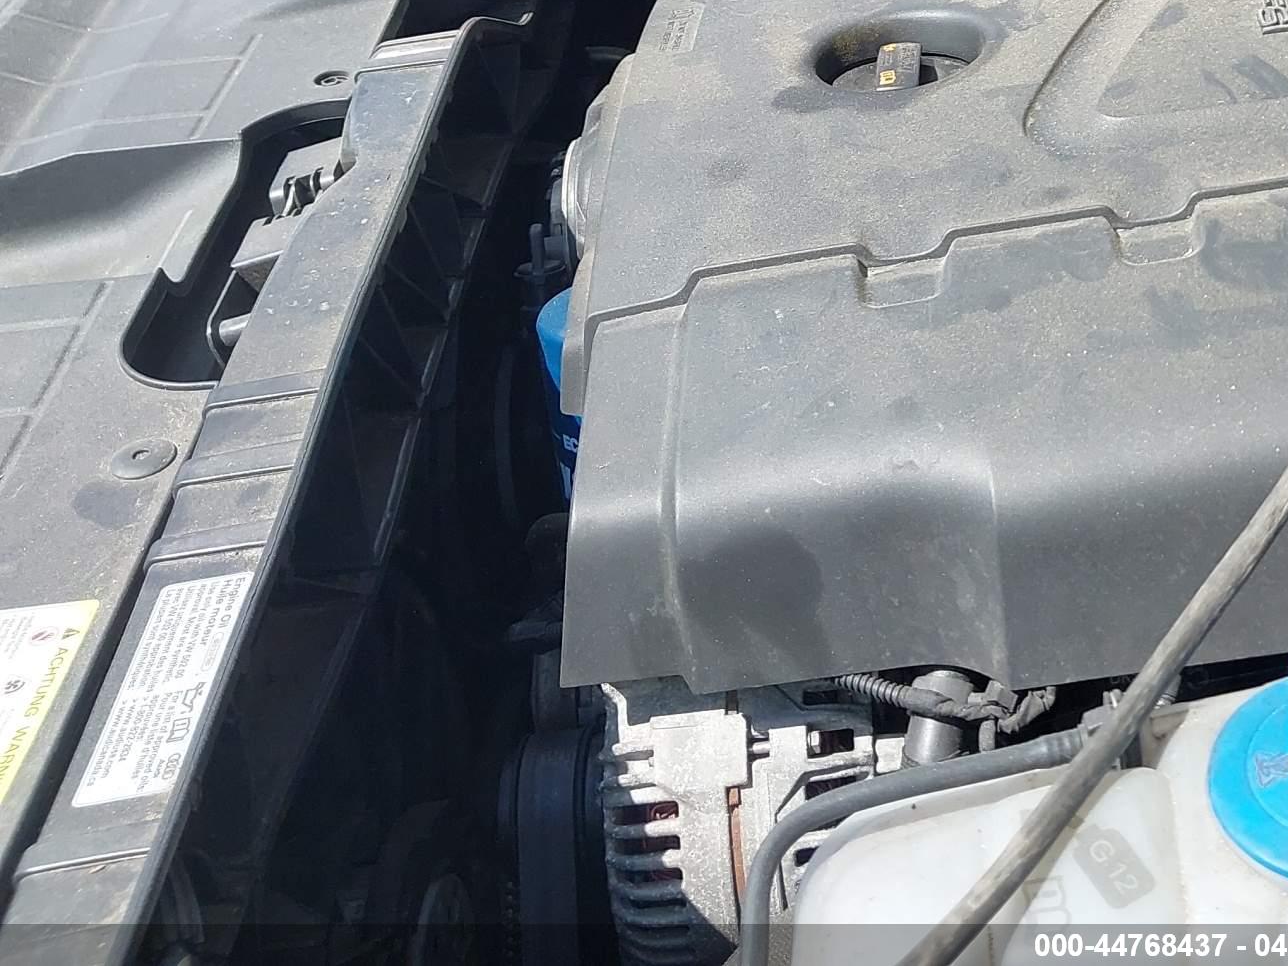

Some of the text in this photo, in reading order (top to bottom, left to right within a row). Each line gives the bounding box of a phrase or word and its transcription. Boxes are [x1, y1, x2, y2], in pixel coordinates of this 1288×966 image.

[213, 578, 234, 605] Huile
[217, 576, 246, 628] Engine Oil
[197, 606, 222, 647] moteur
[24, 646, 69, 719] ACHTUNG
[141, 734, 166, 774] approved
